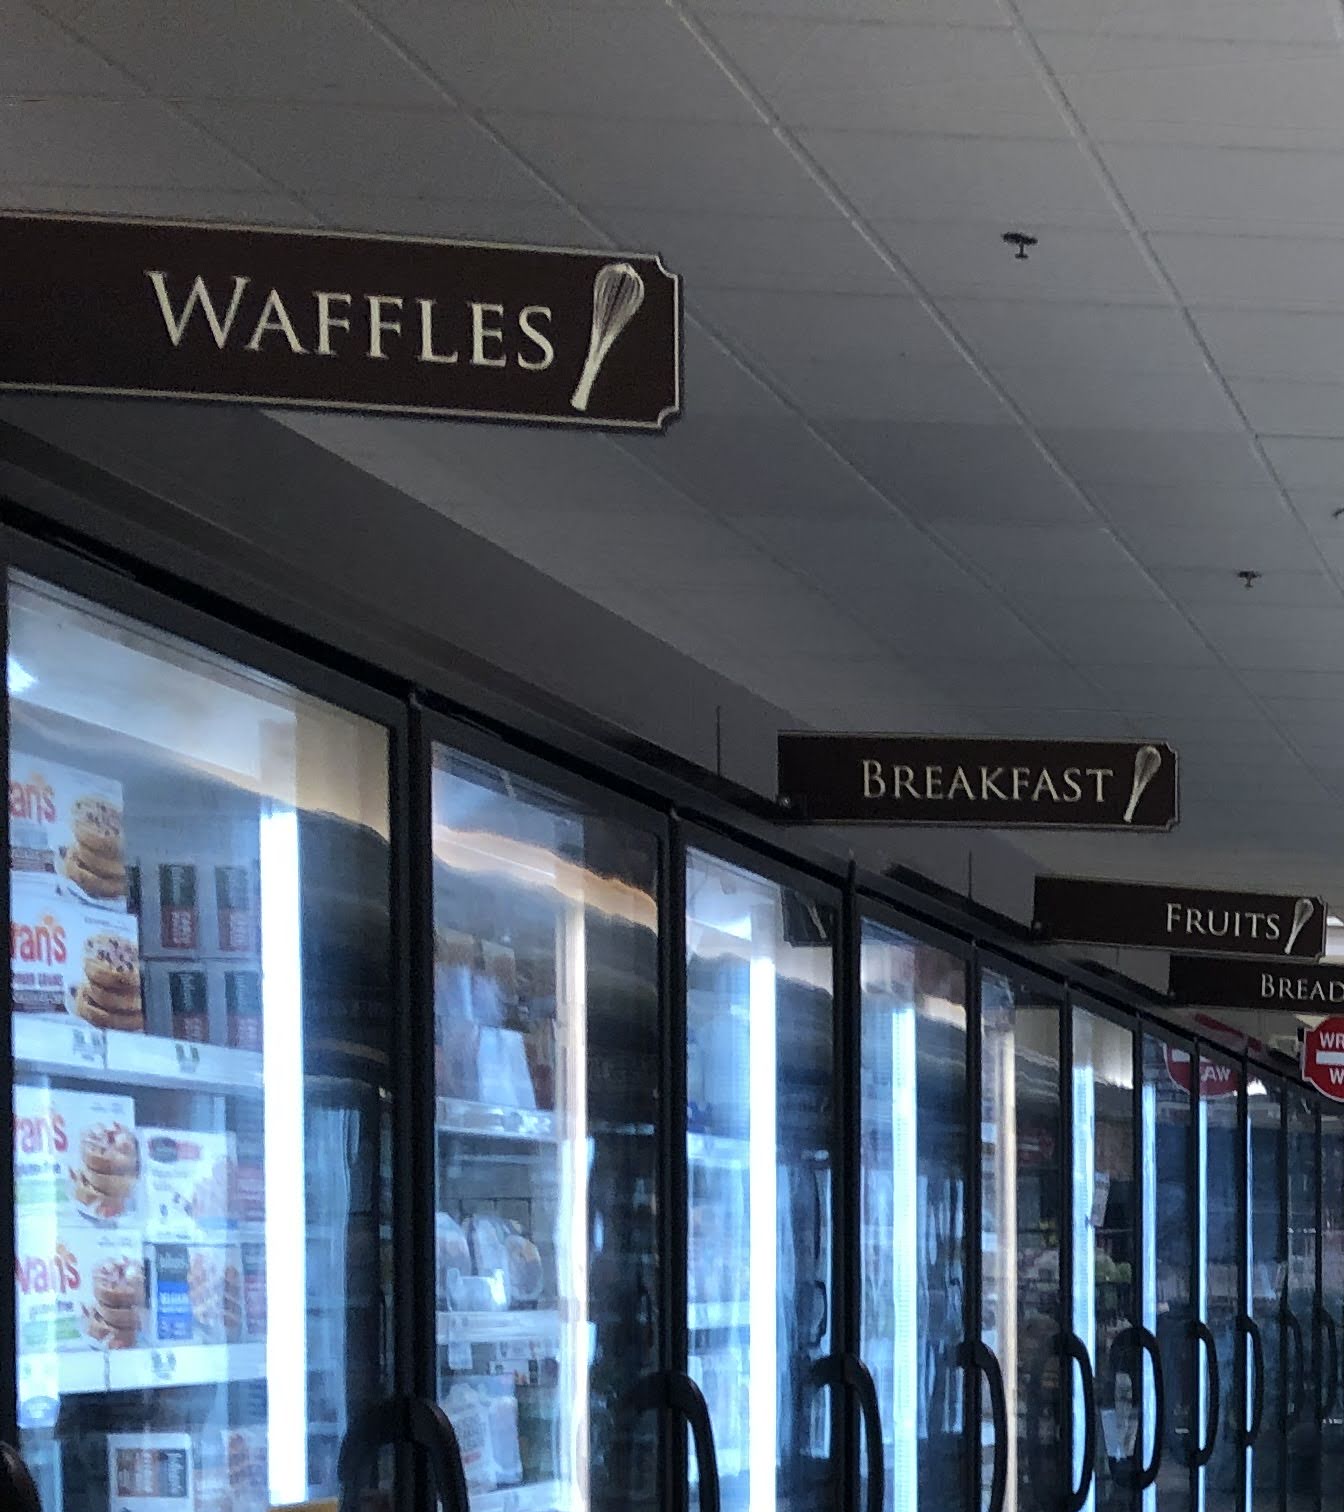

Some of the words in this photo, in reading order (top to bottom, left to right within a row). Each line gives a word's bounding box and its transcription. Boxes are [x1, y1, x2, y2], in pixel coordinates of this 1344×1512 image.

[144, 270, 556, 372] WAFFLES
[862, 759, 1114, 803] BREAKFAST
[1166, 903, 1280, 940] FRUITS
